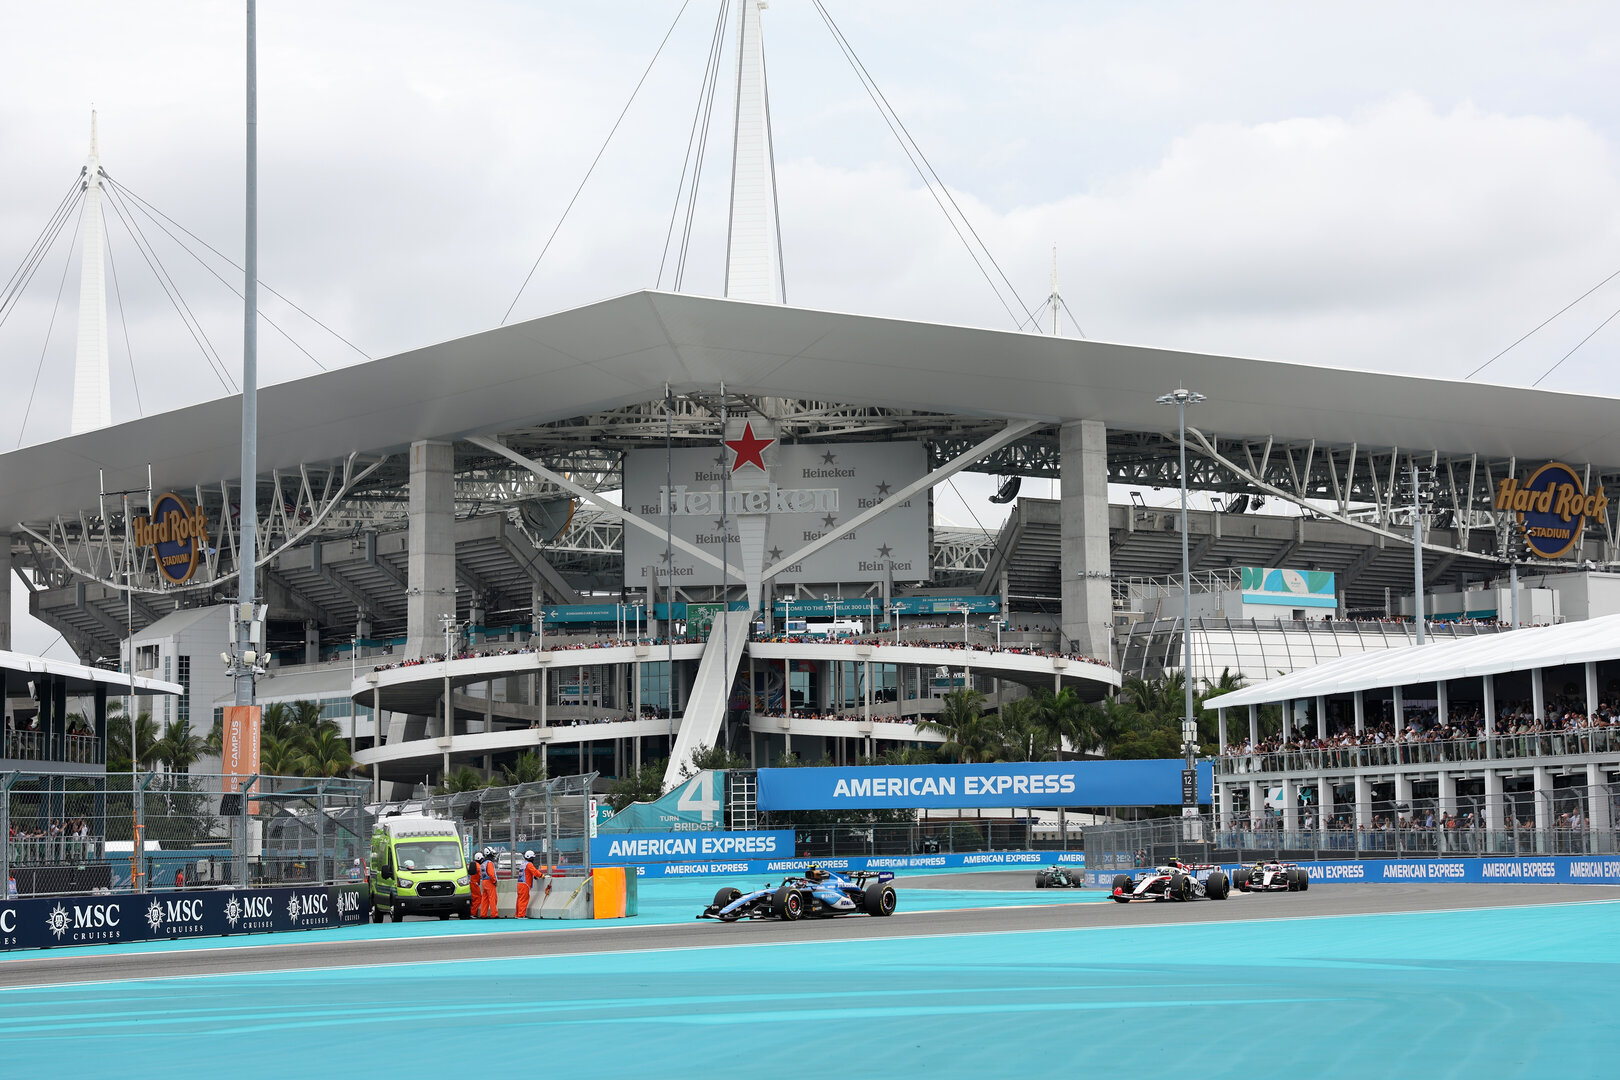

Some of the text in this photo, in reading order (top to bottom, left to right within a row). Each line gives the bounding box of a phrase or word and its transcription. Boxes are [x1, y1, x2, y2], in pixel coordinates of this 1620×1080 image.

[802, 468, 856, 479] Heineken
[659, 483, 838, 516] Heineken
[1495, 478, 1609, 524] Hard Rock
[133, 505, 210, 548] Hard Rock
[1529, 526, 1571, 540] STADIUM
[162, 553, 190, 568] STADIUM
[858, 561, 912, 571] Heinken
[641, 567, 694, 578] Hineken
[231, 720, 239, 768] CAMPUS
[833, 774, 1076, 797] AMERICAN EXPRESS
[1184, 776, 1192, 785] 12
[677, 770, 720, 822] 4
[674, 822, 714, 832] BRIDGE
[608, 836, 776, 857] AMERICAN EXPRESS
[767, 860, 849, 871] AMERICAN EXPRESS
[866, 857, 946, 867] AMERICAN EXPRESS
[963, 853, 1041, 864] AMERICAN EXPRESS
[664, 863, 749, 874] AMERICAN EXPRESS
[1325, 864, 1364, 878] EXPRESS
[1383, 863, 1465, 878] AMERICAN EXPRESS
[1482, 862, 1556, 877] AMERICAN EXPRESS
[1569, 861, 1620, 877] AMERICAN EXPR
[243, 896, 273, 918] MSC
[301, 893, 328, 915] MSC
[344, 891, 360, 912] MSC
[73, 904, 120, 929] MSC
[166, 899, 203, 923] MSC
[243, 920, 273, 929] CRUISES
[301, 917, 328, 925] CRUISES
[73, 931, 121, 940] CRUISES
[166, 924, 203, 934] CRUISES
